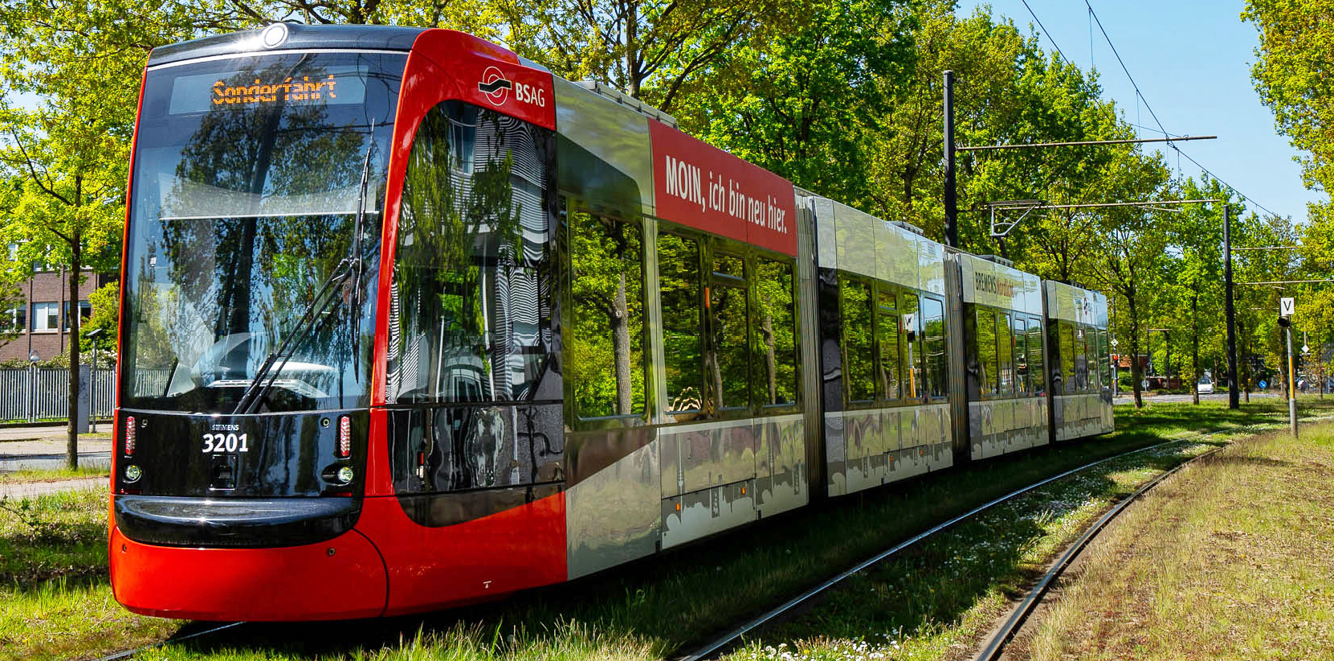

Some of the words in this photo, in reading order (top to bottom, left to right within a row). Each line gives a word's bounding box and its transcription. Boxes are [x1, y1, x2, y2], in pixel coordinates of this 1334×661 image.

[213, 74, 336, 105] Sonderfahrt
[515, 82, 545, 107] BSAG
[666, 155, 706, 213] MOIN,
[709, 171, 725, 213] ich
[729, 179, 745, 220] bin
[748, 196, 766, 227] neu
[768, 194, 787, 234] hier.
[1283, 300, 1292, 311] V
[202, 433, 248, 453] 3201
